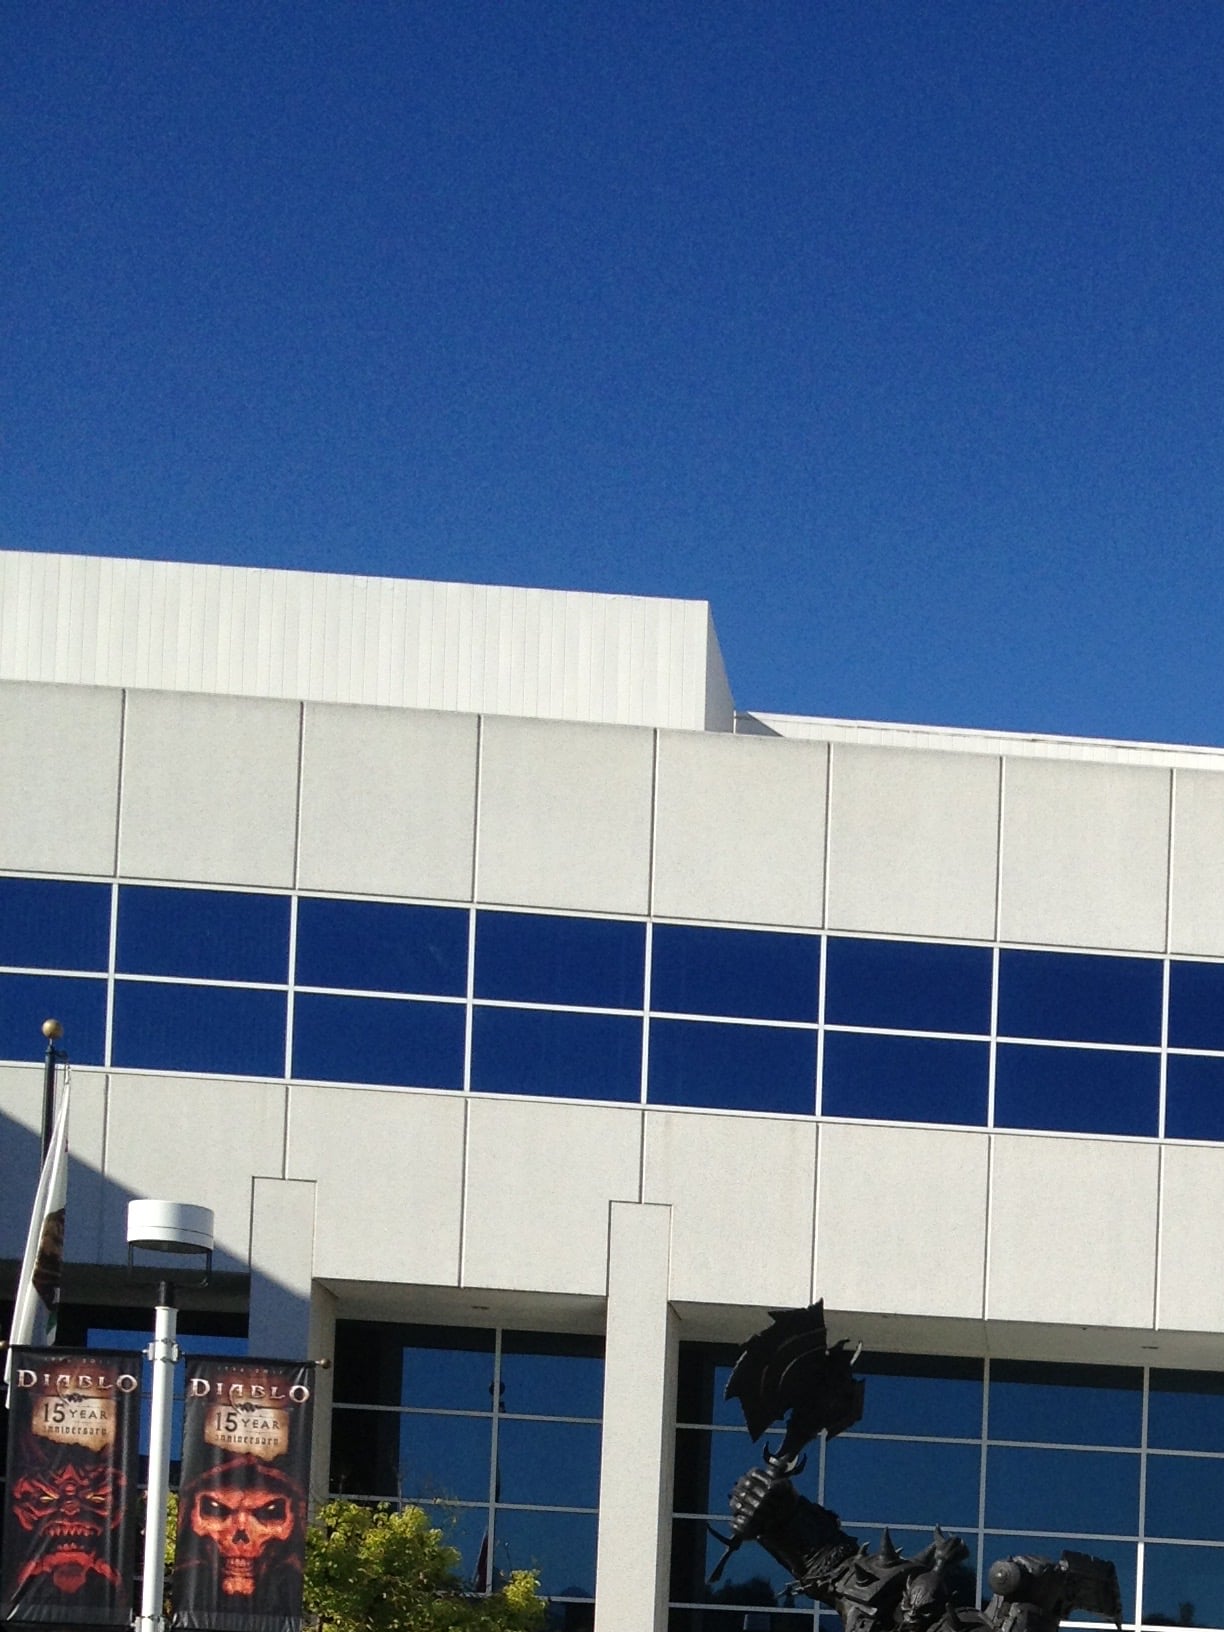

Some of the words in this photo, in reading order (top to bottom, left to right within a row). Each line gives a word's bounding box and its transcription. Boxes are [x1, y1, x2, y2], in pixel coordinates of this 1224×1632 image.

[16, 1369, 138, 1393] DIABLO
[190, 1378, 310, 1403] DIABLO
[43, 1402, 66, 1423] 15
[69, 1409, 108, 1420] YEAR
[216, 1411, 238, 1432] 15
[241, 1418, 281, 1430] YEAR
